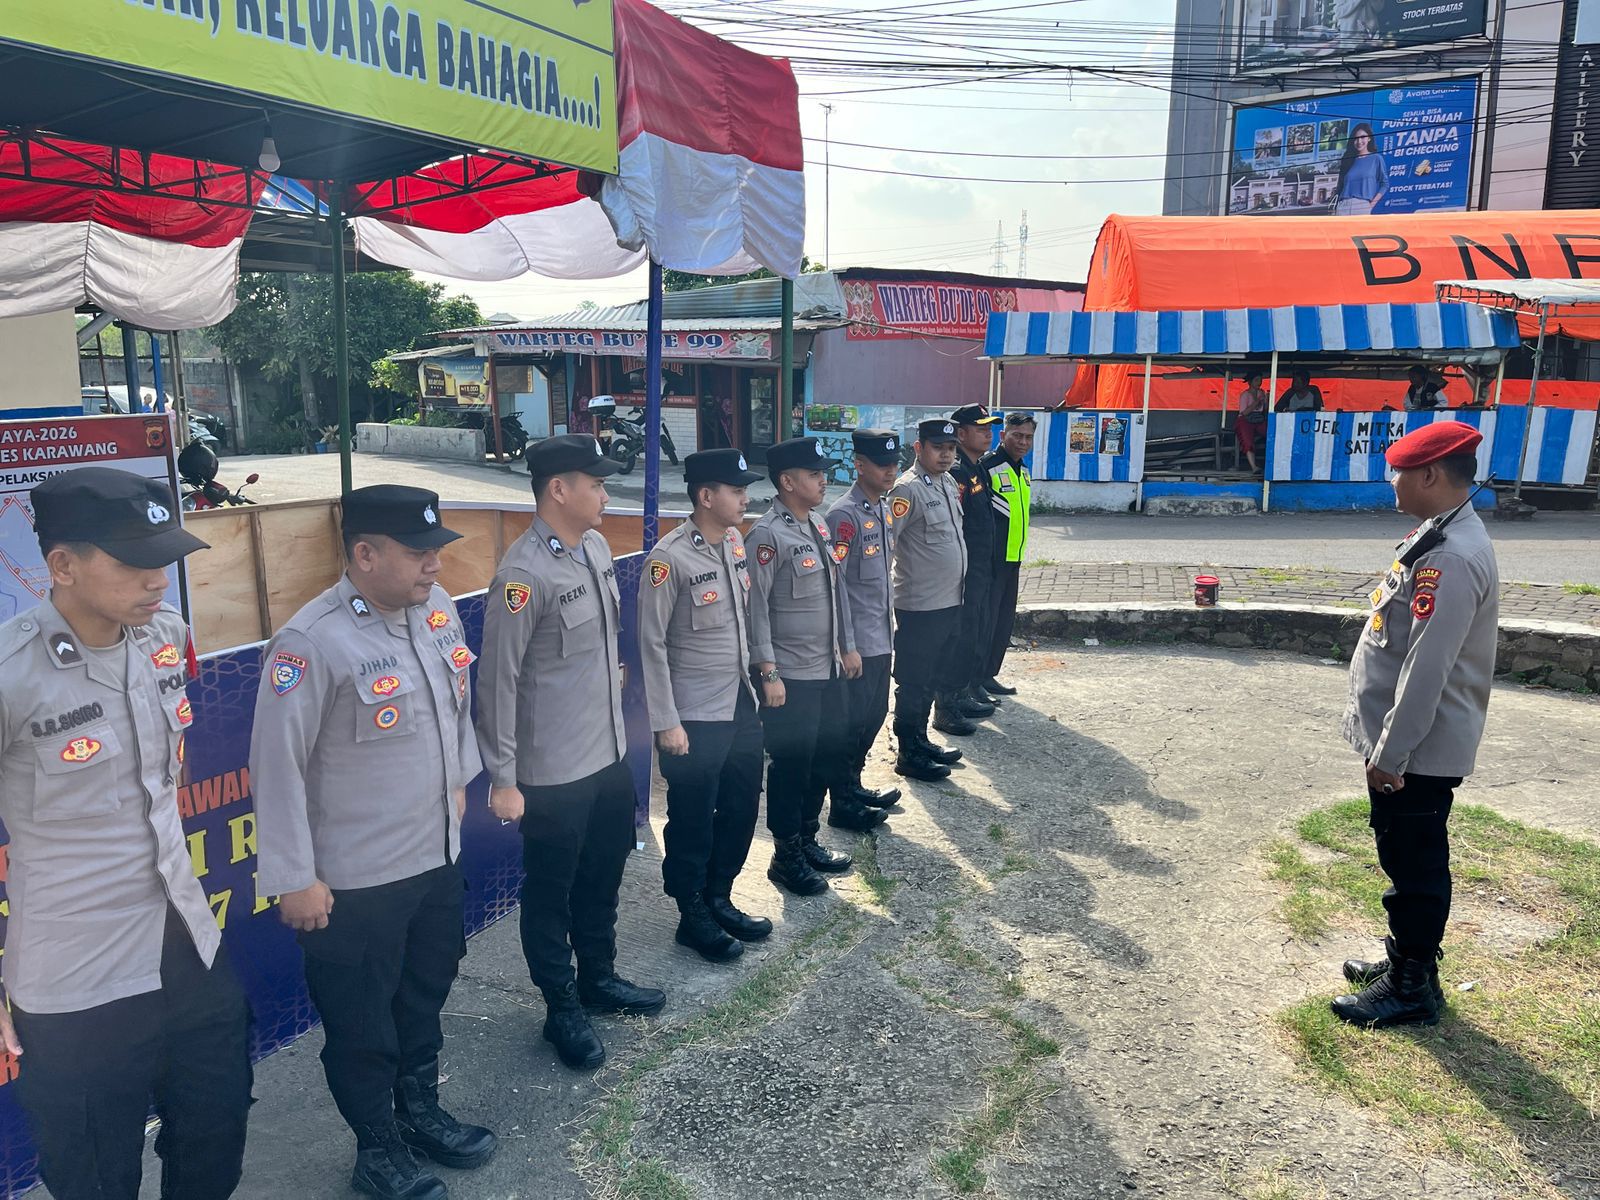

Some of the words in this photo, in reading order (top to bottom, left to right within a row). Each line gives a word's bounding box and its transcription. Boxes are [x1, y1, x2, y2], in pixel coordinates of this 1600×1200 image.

[1402, 9, 1426, 19] STOCK
[1428, 2, 1464, 15] TERBATAS
[1420, 112, 1462, 124] RUMAH
[1396, 126, 1459, 147] TANPA
[1394, 149, 1404, 157] BI
[1405, 143, 1460, 156] CHECKING
[1390, 185, 1413, 193] STOCK
[877, 284, 938, 325] WARTEG
[495, 332, 595, 348] WARTEG
[601, 333, 678, 348] BU'E
[686, 333, 724, 349] 99
[1301, 419, 1340, 435] OJEK
[1357, 422, 1404, 437] MITRA
[22, 442, 118, 461] KARAWANG
[690, 571, 717, 586] LUCKY
[559, 584, 587, 606] REZKI
[360, 656, 398, 676] JIHAD
